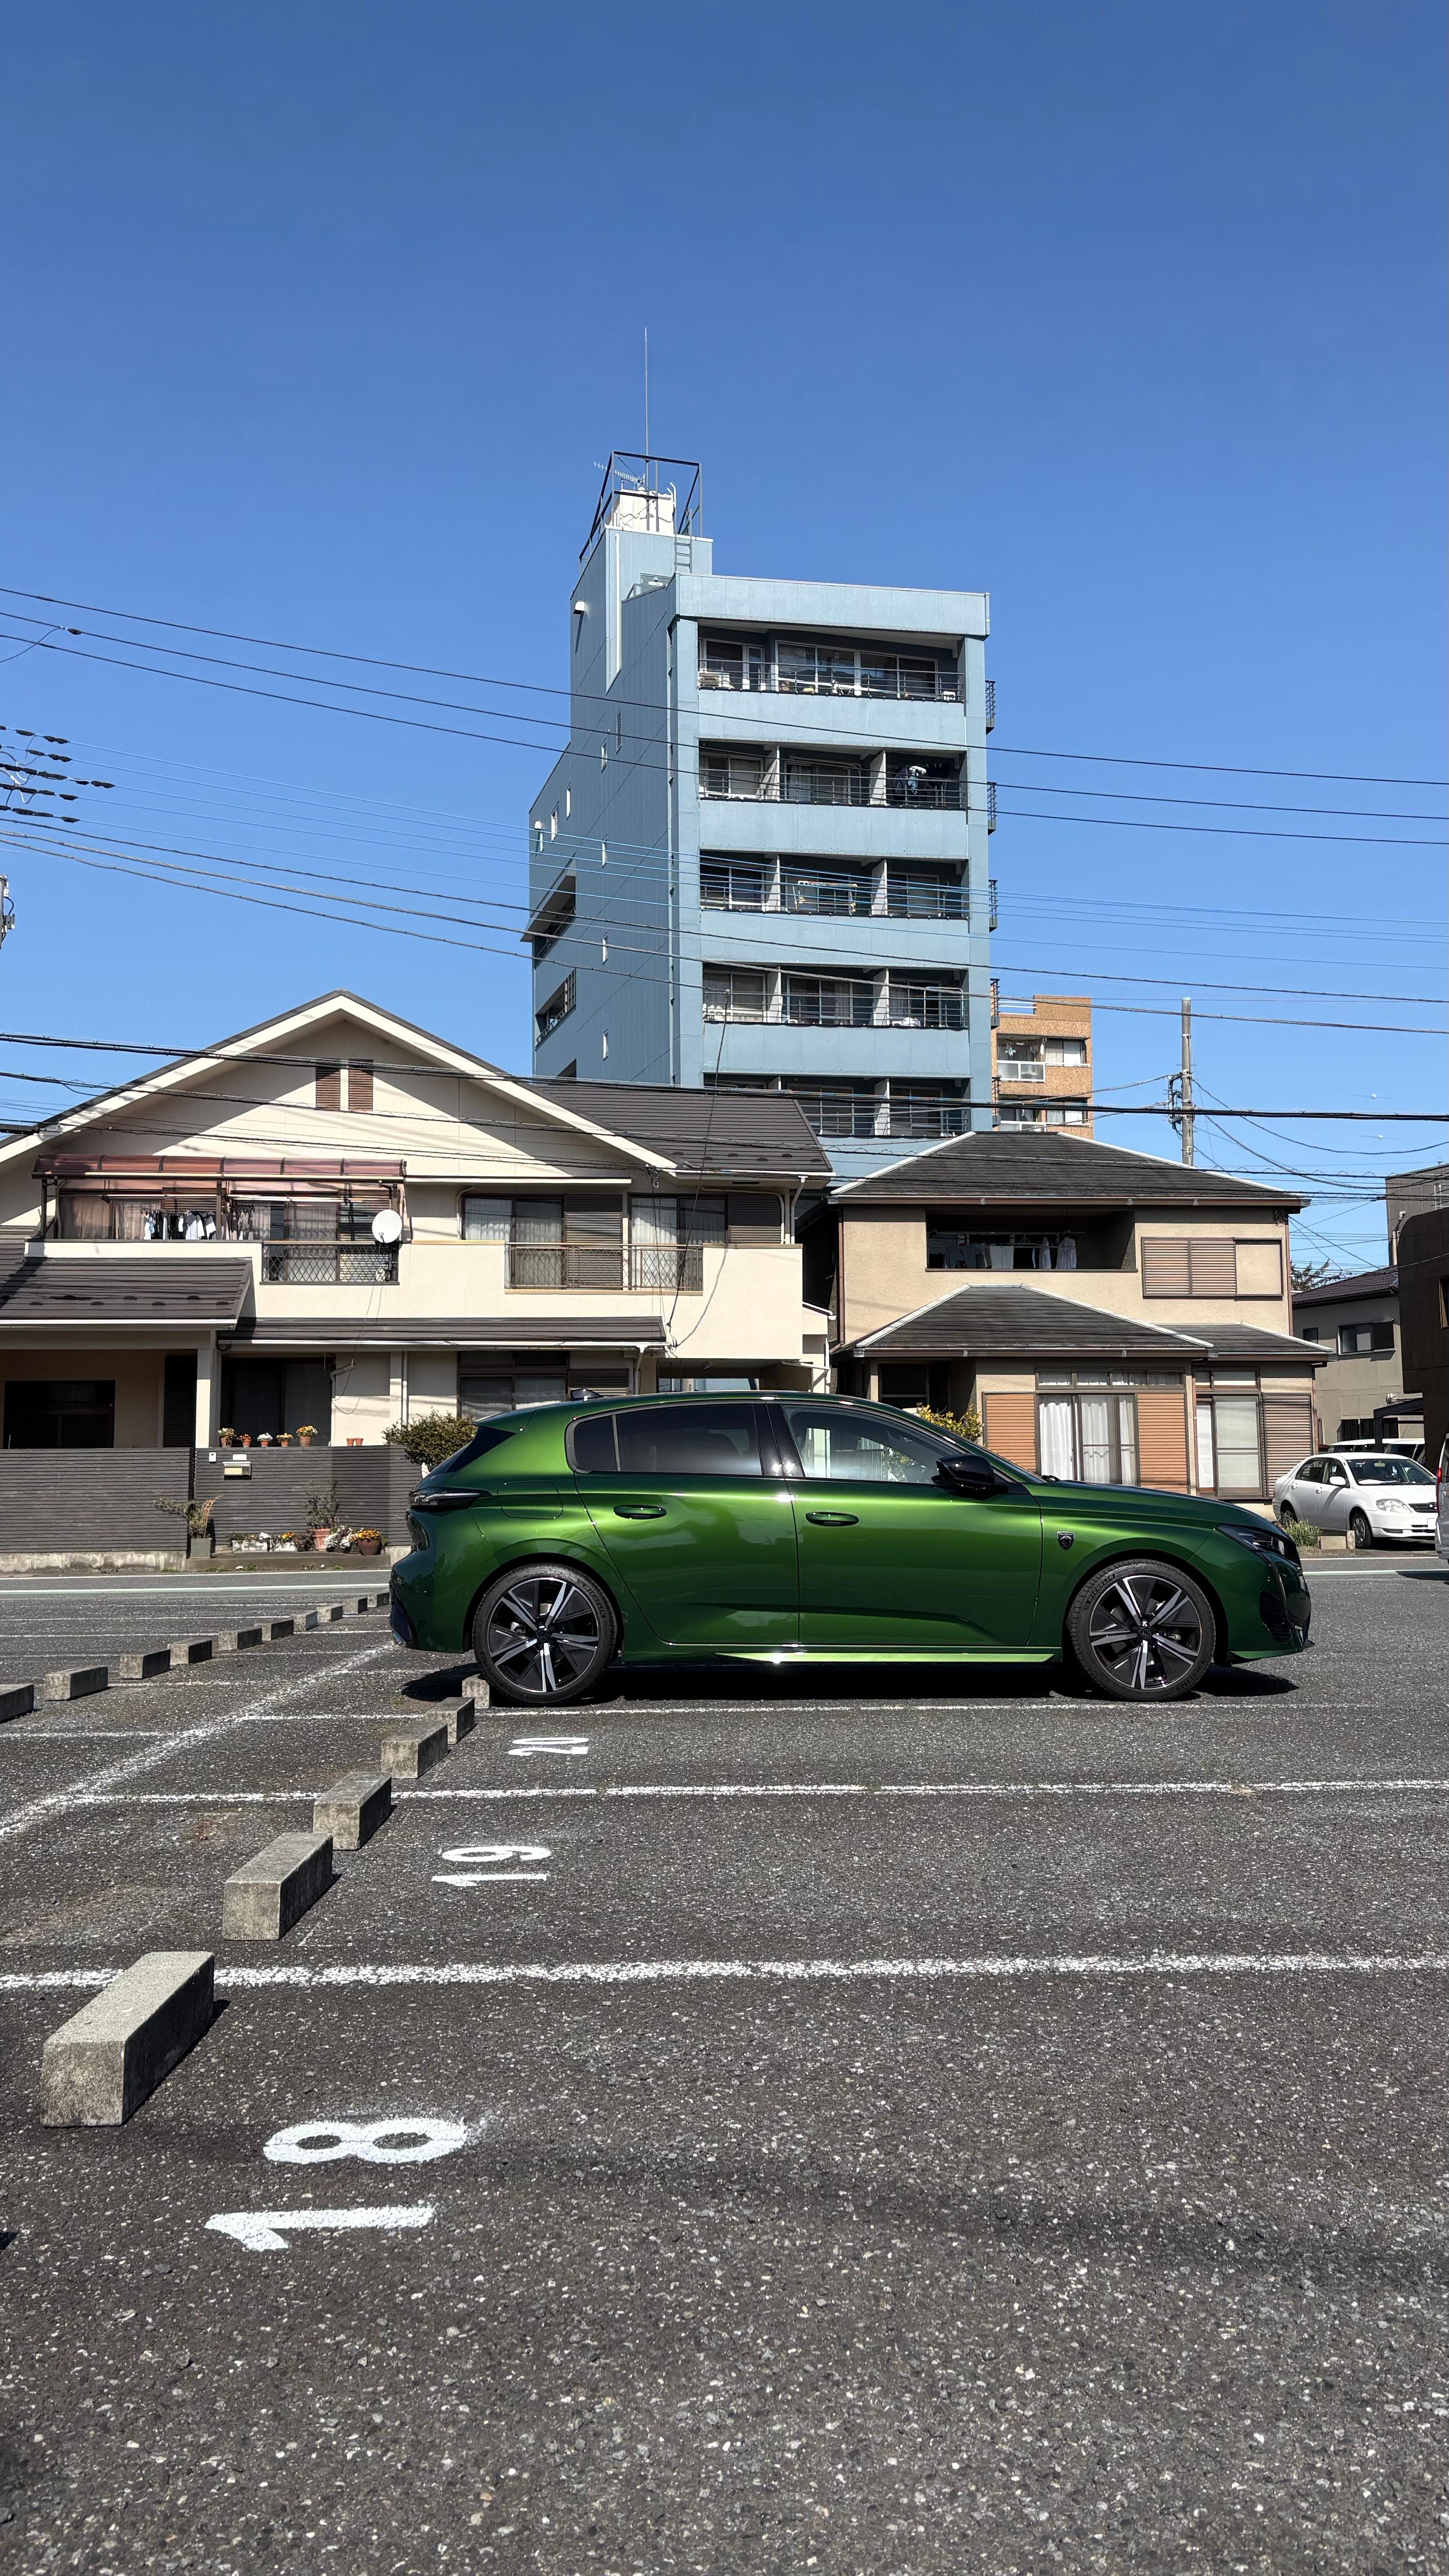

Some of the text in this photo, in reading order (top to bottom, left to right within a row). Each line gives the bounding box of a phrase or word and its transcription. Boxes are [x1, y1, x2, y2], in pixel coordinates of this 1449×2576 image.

[507, 1736, 589, 1757] 20
[431, 1844, 552, 1887] 19
[204, 2114, 469, 2252] 18
